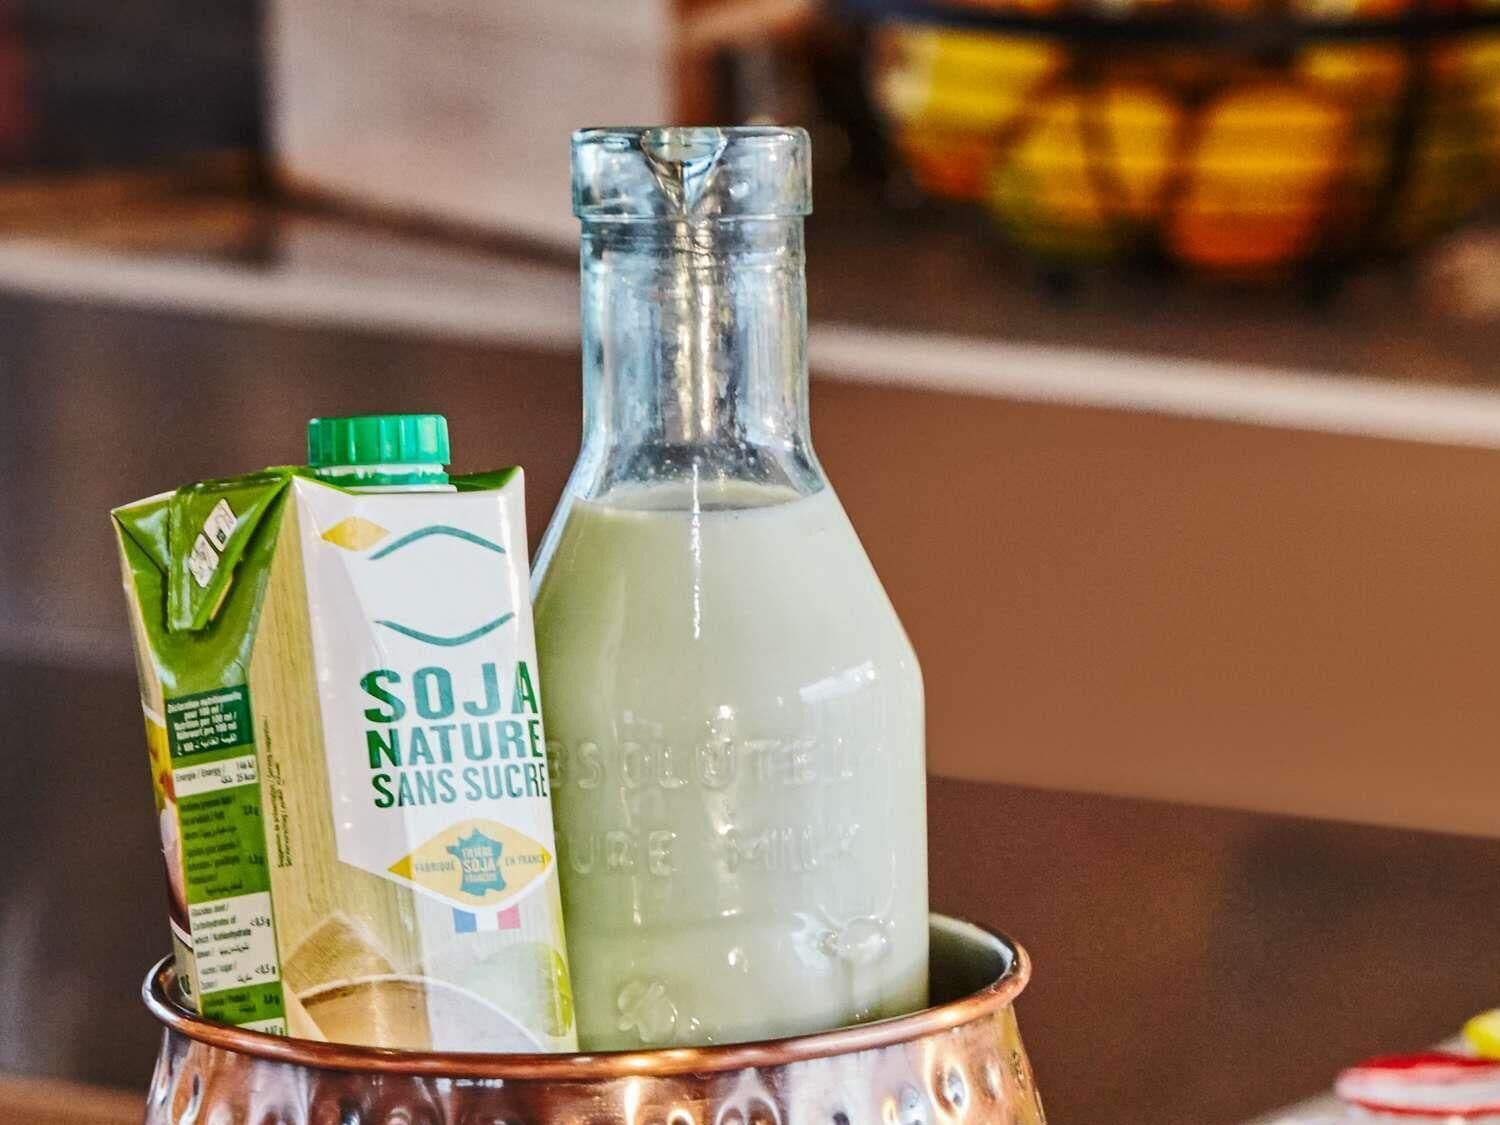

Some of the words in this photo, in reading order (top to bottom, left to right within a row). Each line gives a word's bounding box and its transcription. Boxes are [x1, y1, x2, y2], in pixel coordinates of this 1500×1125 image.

[360, 661, 538, 723] SOJA
[366, 719, 543, 769] NATURE
[371, 768, 457, 808] SANS
[462, 762, 547, 801] SUCRE
